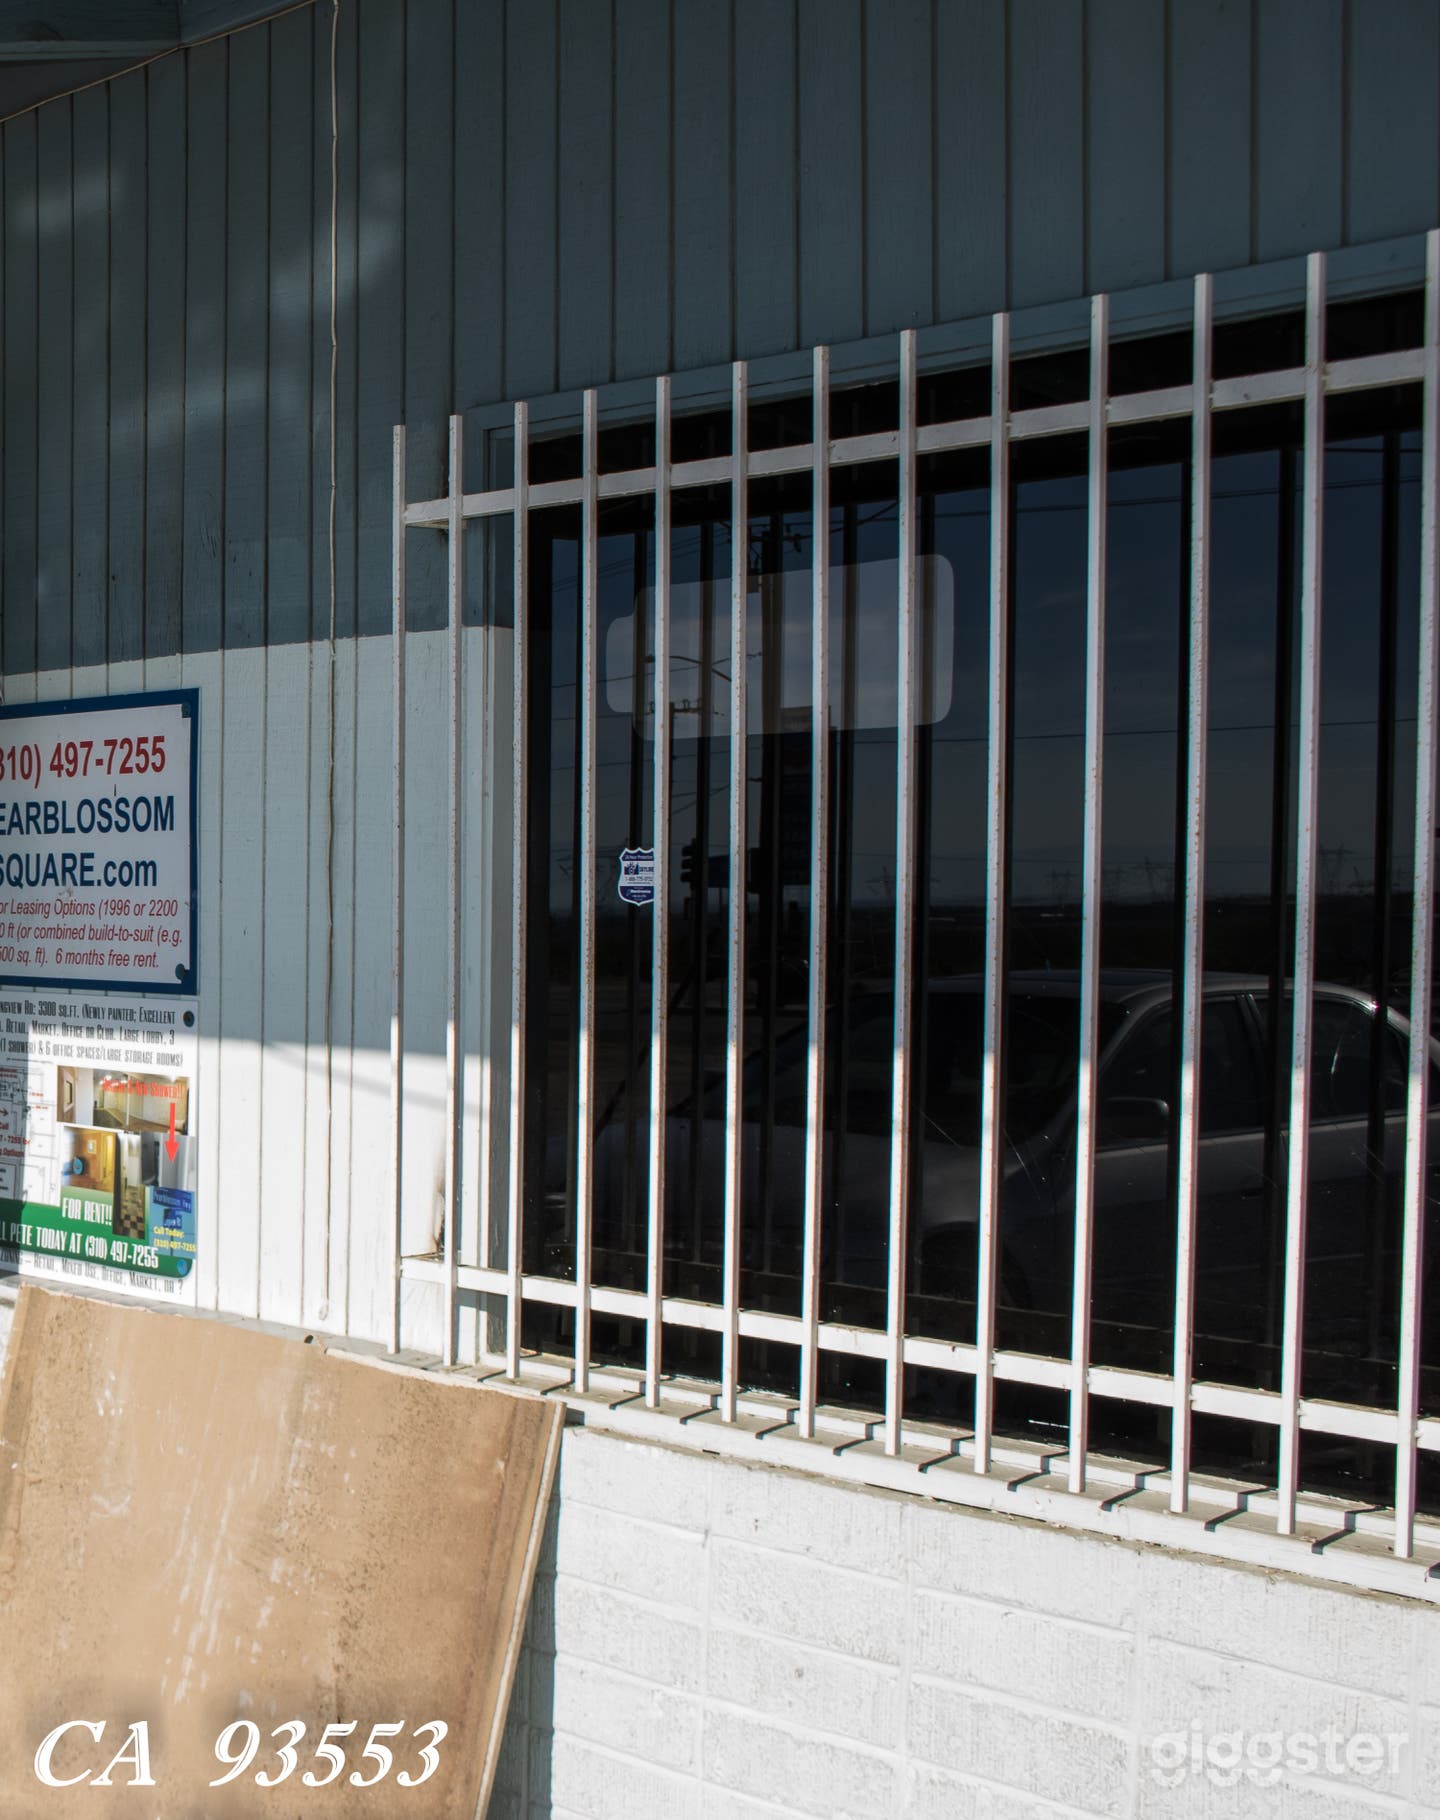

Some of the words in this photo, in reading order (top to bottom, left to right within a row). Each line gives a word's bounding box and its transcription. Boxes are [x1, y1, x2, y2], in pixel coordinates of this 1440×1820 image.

[49, 735, 166, 779] 497-7255
[10, 899, 50, 919] Leasing
[54, 899, 96, 920] Options
[99, 899, 131, 921] (1996
[133, 904, 146, 917] or
[148, 899, 179, 918] 2200
[8, 922, 16, 938] ft
[17, 923, 32, 944] (or
[33, 923, 85, 941] combined
[88, 924, 154, 944] build-to-suit
[157, 925, 183, 947] (e.g.
[16, 950, 32, 967] sq.
[55, 947, 63, 963] 6
[64, 948, 106, 966] months
[107, 948, 130, 968] free
[132, 949, 161, 969] rent.
[38, 1000, 57, 1018] 3300
[169, 1028, 176, 1046] 3
[61, 1196, 82, 1221] FOR
[84, 1202, 113, 1226] RENT!!
[10, 1221, 32, 1247] PETE
[36, 1226, 68, 1251] TODAY
[69, 1232, 83, 1254] AT
[84, 1234, 108, 1260] (310)
[110, 1240, 159, 1269] 497-7255
